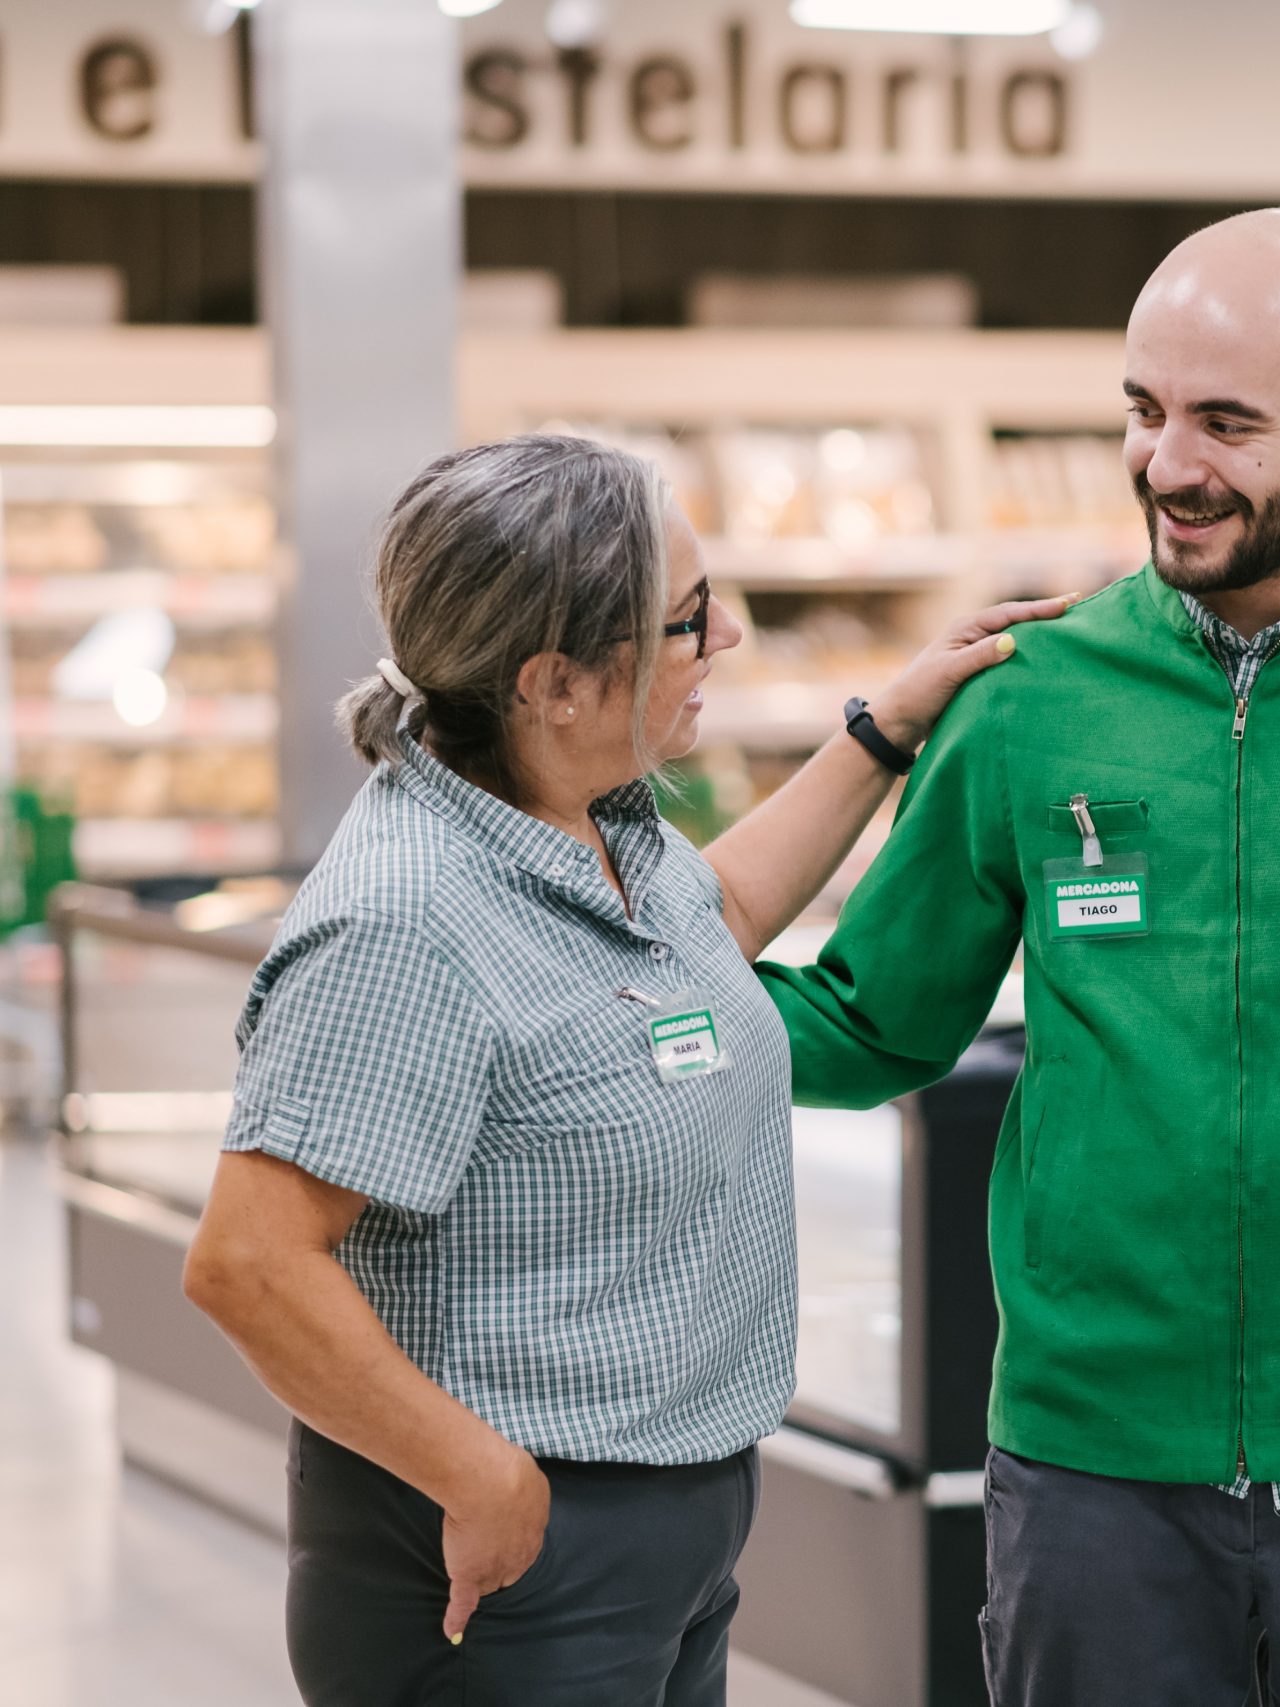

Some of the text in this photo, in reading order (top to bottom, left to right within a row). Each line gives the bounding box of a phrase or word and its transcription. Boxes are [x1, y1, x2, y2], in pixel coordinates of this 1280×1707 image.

[80, 10, 1073, 158] e stelaria
[1056, 880, 1139, 897] MERCADONA
[1079, 904, 1118, 917] TIAGO
[653, 1014, 711, 1039] MERCADONA
[672, 1041, 702, 1056] MARIA
